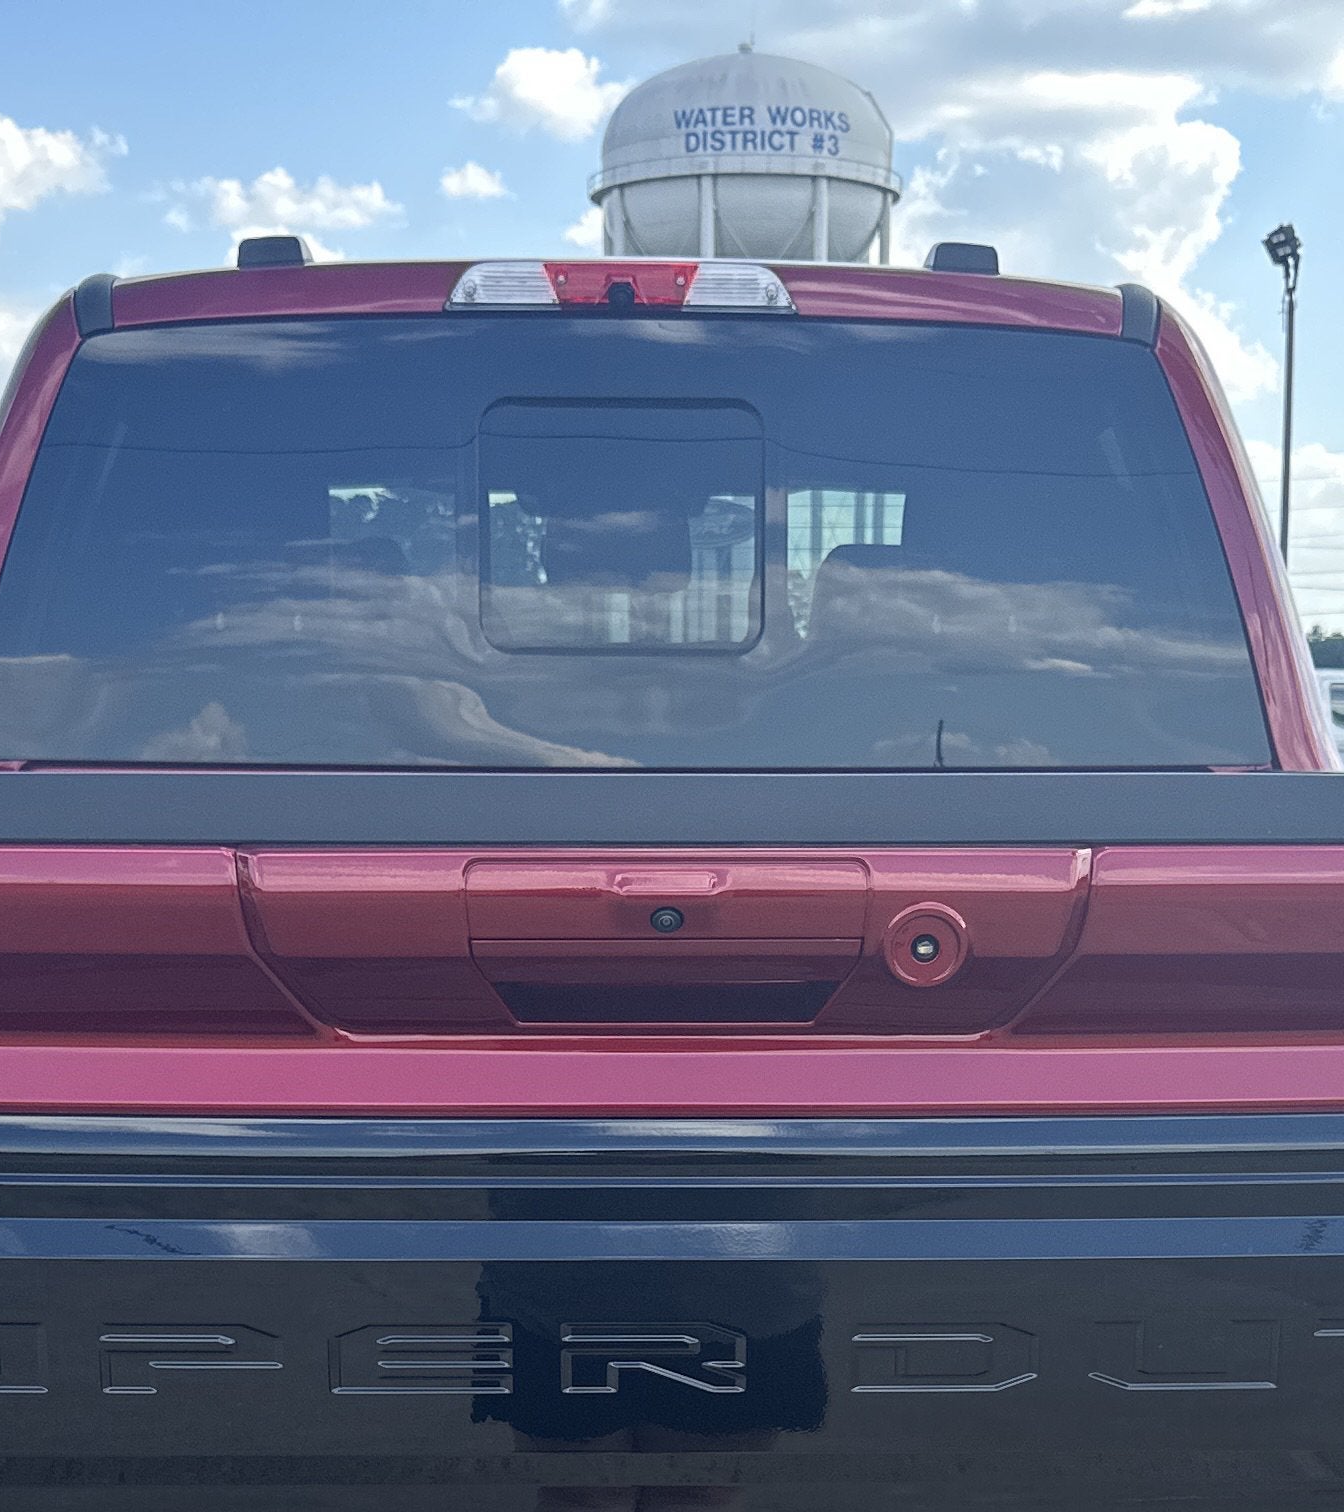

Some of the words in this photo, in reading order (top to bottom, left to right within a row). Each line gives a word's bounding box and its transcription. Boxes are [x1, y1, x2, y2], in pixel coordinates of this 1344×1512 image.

[673, 105, 755, 130] WATER
[766, 105, 852, 133] WORKS
[684, 130, 800, 154] DISTRICT
[811, 133, 841, 157] #3
